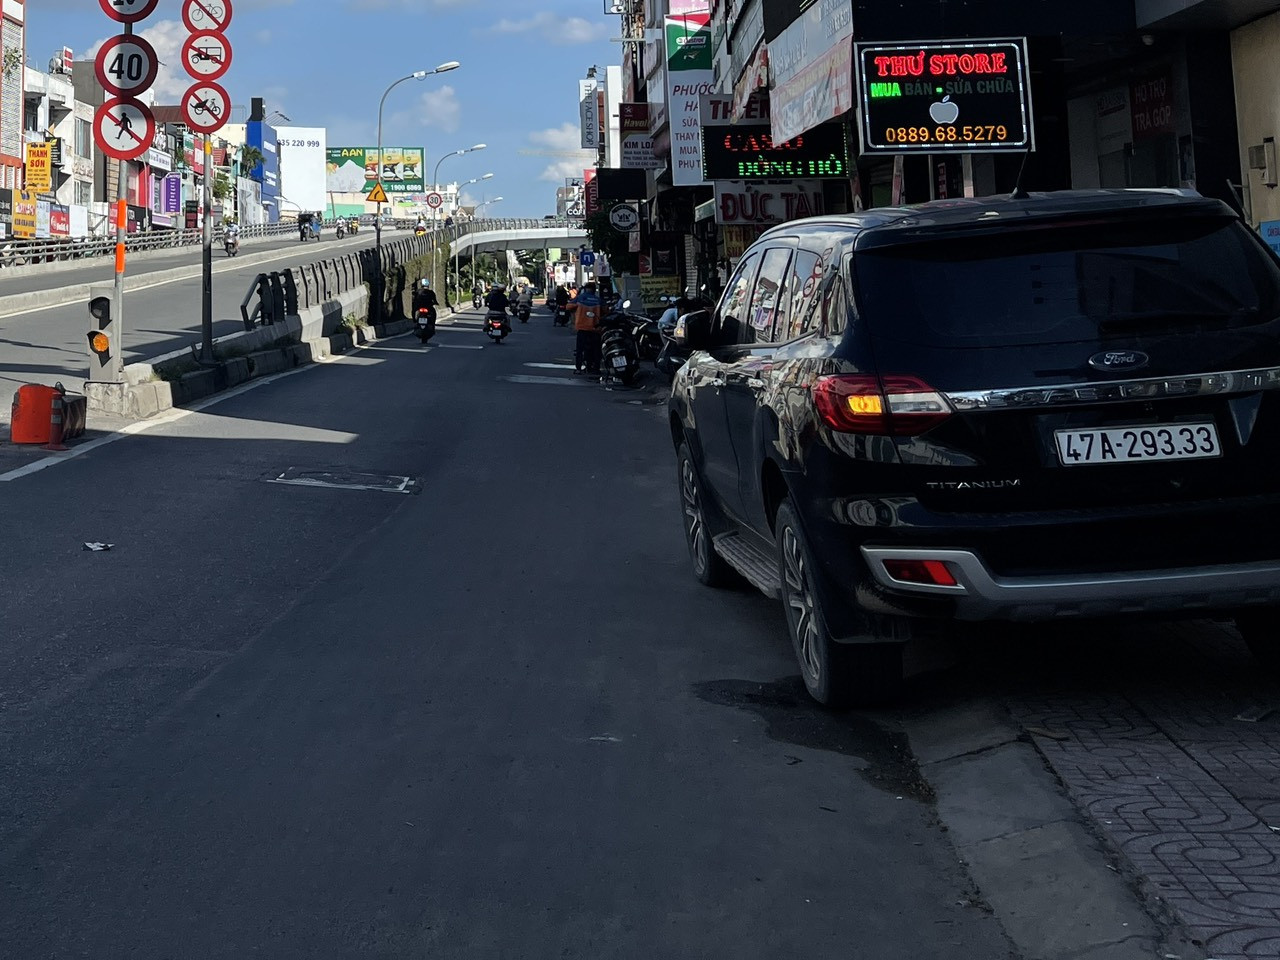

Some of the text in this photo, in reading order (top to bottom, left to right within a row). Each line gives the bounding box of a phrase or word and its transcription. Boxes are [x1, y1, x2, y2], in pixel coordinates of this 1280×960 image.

[108, 53, 142, 81] 40
[875, 51, 1007, 76] THƯ STORE
[673, 81, 715, 96] PHƯỚC
[871, 77, 1014, 98] MUA BÁN SỬA CHỮA
[584, 84, 594, 146] THE FACE SHOP
[682, 114, 698, 127] SỬA
[675, 132, 695, 141] THAY
[886, 125, 1007, 142] 0889.68.5279
[292, 139, 320, 148] 220 999
[624, 141, 638, 149] KIM
[28, 150, 48, 158] THANH
[679, 146, 698, 155] MUA
[30, 159, 45, 168] SƠN
[678, 159, 695, 170] PHỤ
[430, 196, 439, 205] 30
[1104, 352, 1136, 366] Ford
[1066, 426, 1215, 461] 47A-293.33
[926, 479, 1020, 491] TITANIUM
